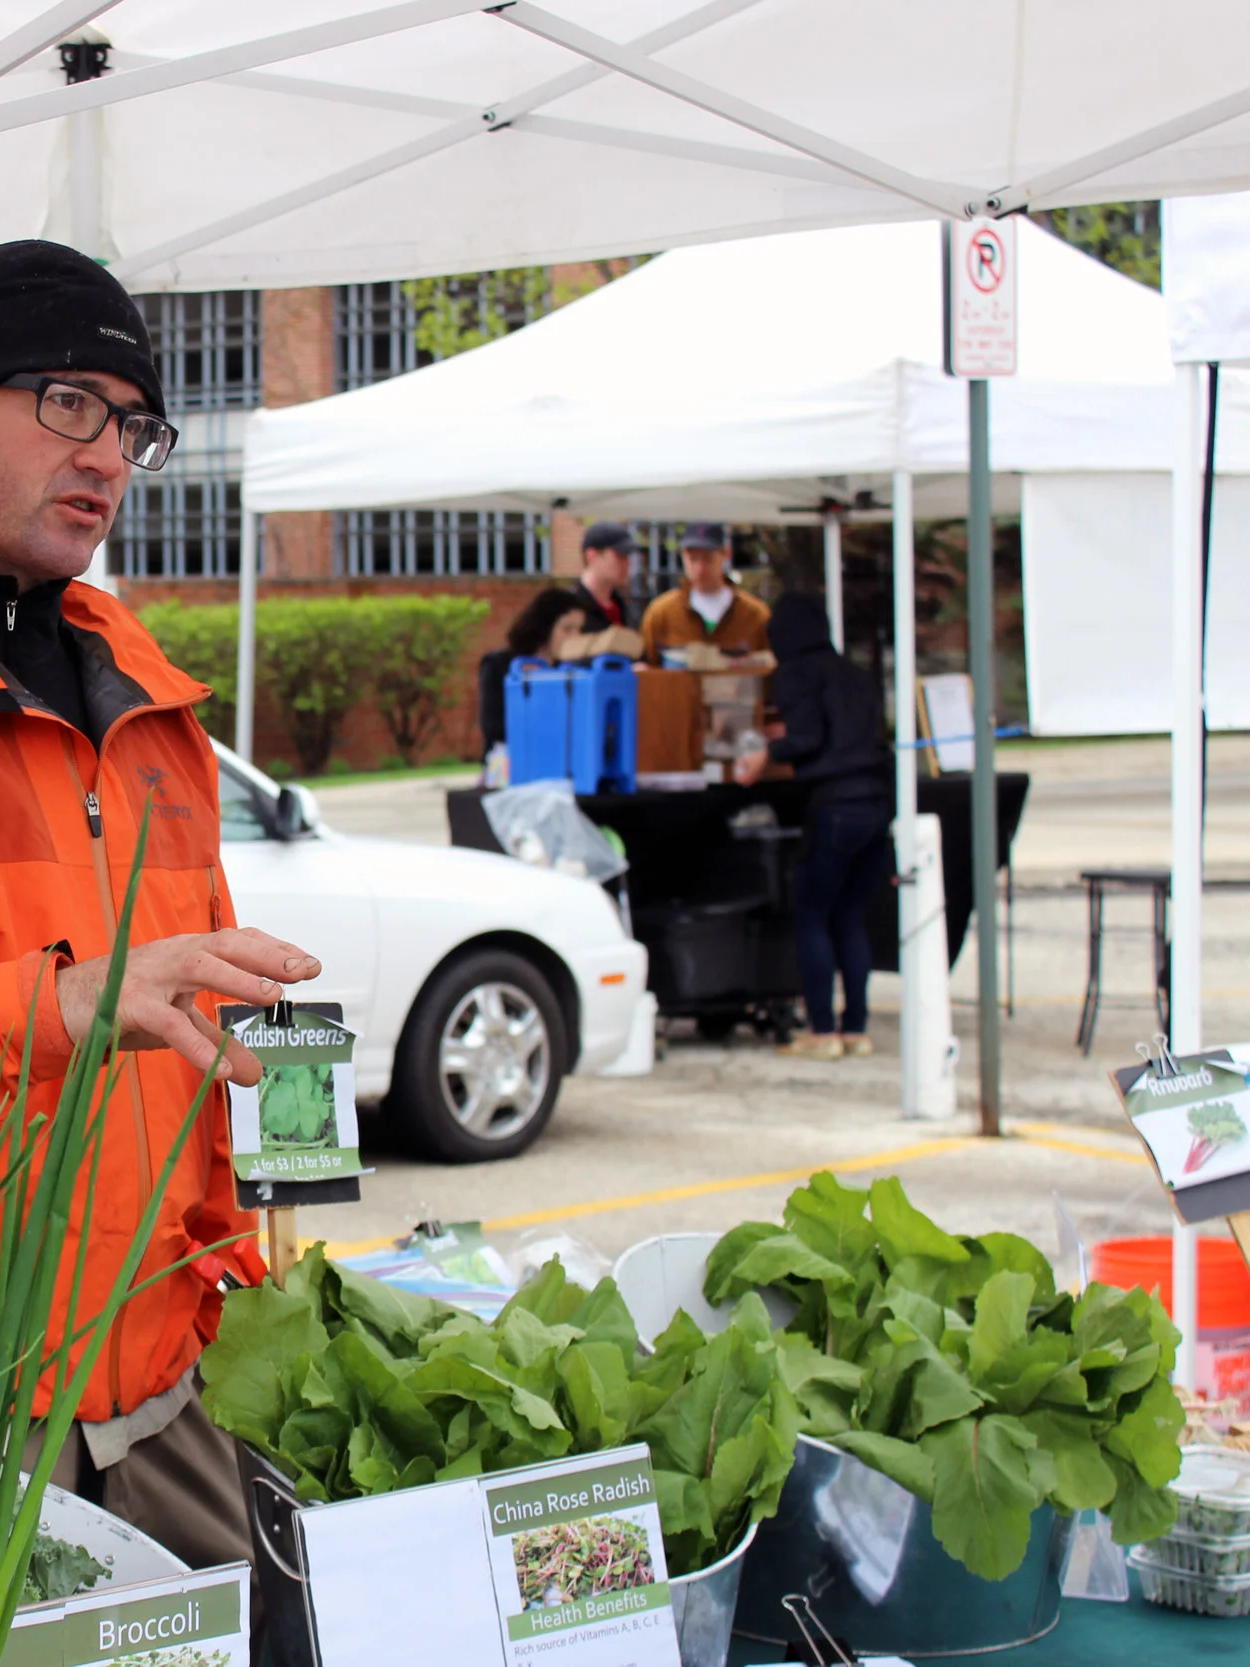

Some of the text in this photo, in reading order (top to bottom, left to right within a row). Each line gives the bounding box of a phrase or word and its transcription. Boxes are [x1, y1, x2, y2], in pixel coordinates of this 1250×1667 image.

[287, 1024, 347, 1047] Greens
[261, 1158, 275, 1172] for
[276, 1156, 289, 1172] $3
[296, 1157, 305, 1170] 2
[305, 1155, 318, 1169] for
[493, 1473, 650, 1525] China Rose Radish
[99, 1601, 200, 1651] Broccoli
[530, 1591, 648, 1632] Health Benefits
[514, 1643, 535, 1657] Rich
[536, 1638, 567, 1652] source
[568, 1633, 579, 1645] of
[579, 1625, 620, 1641] Vitamins
